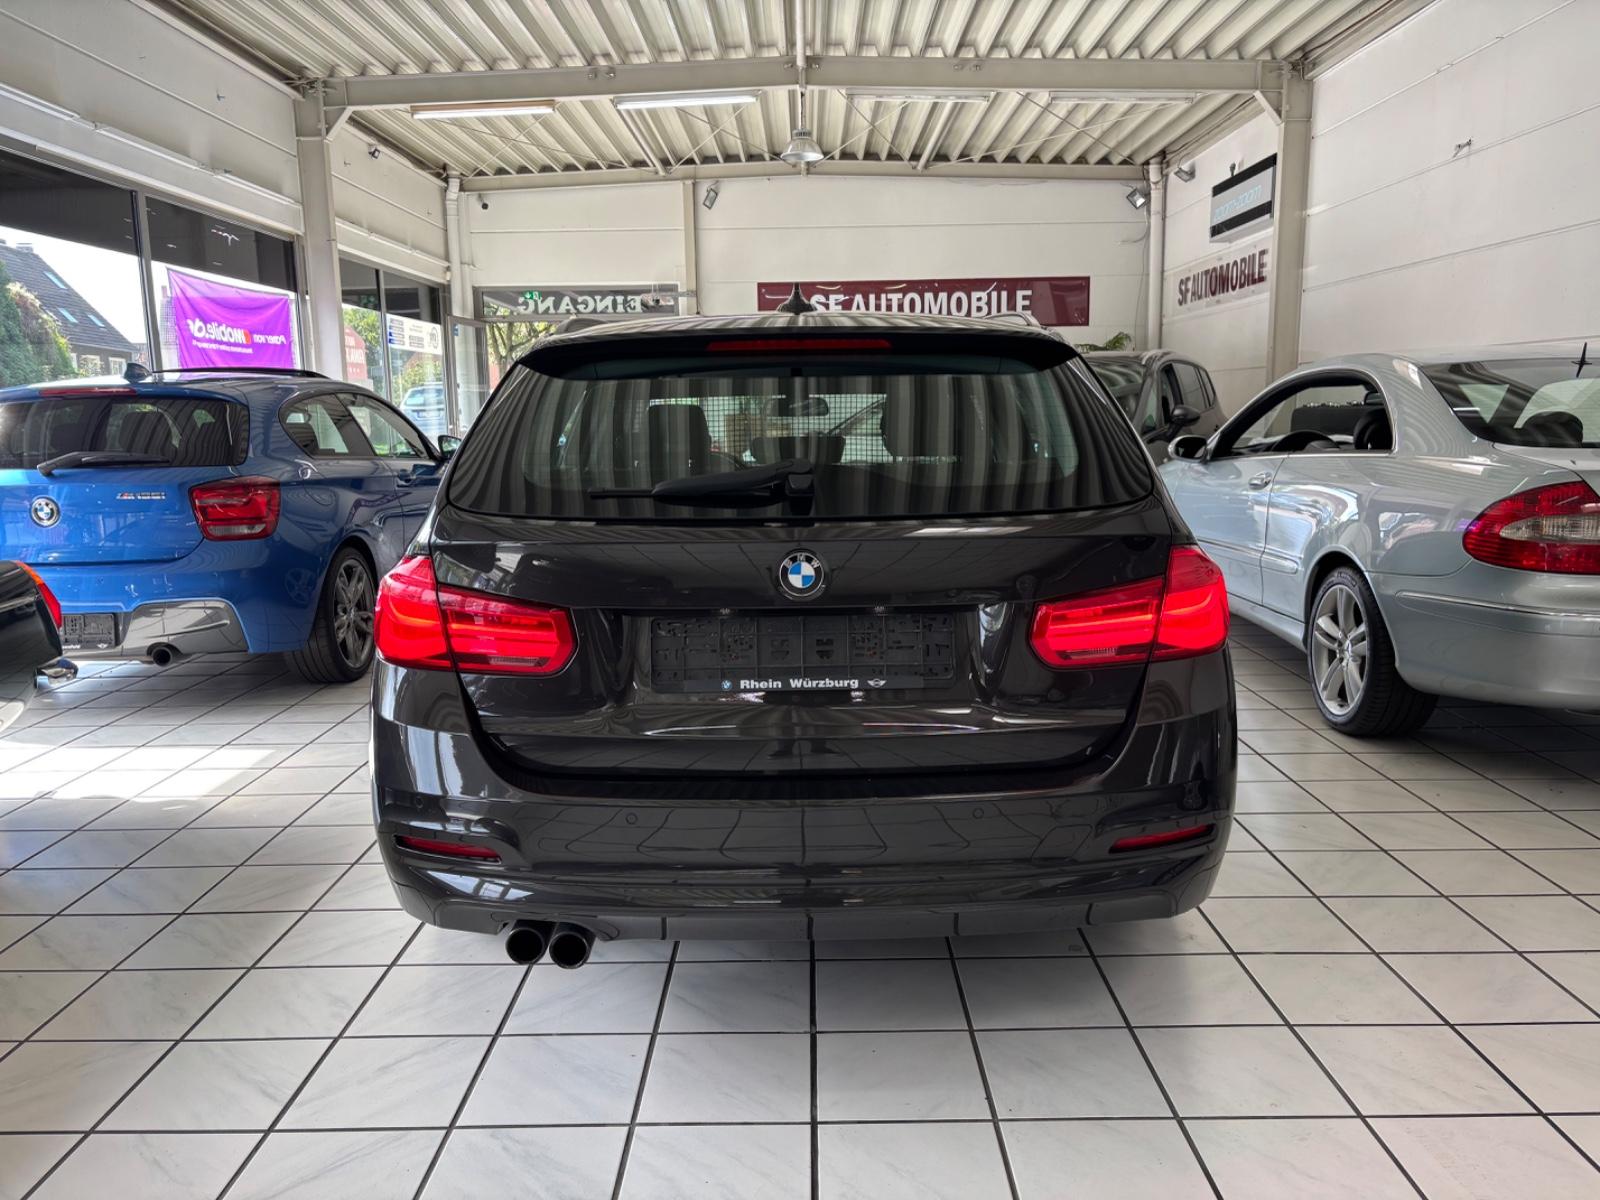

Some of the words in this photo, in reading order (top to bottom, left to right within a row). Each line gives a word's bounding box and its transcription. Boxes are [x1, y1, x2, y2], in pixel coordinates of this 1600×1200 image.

[1191, 250, 1269, 300] AUTOMOBILE
[850, 290, 1034, 318] AUTOMOBILE
[739, 679, 782, 689] Rhein
[789, 678, 859, 690] Würzburg
